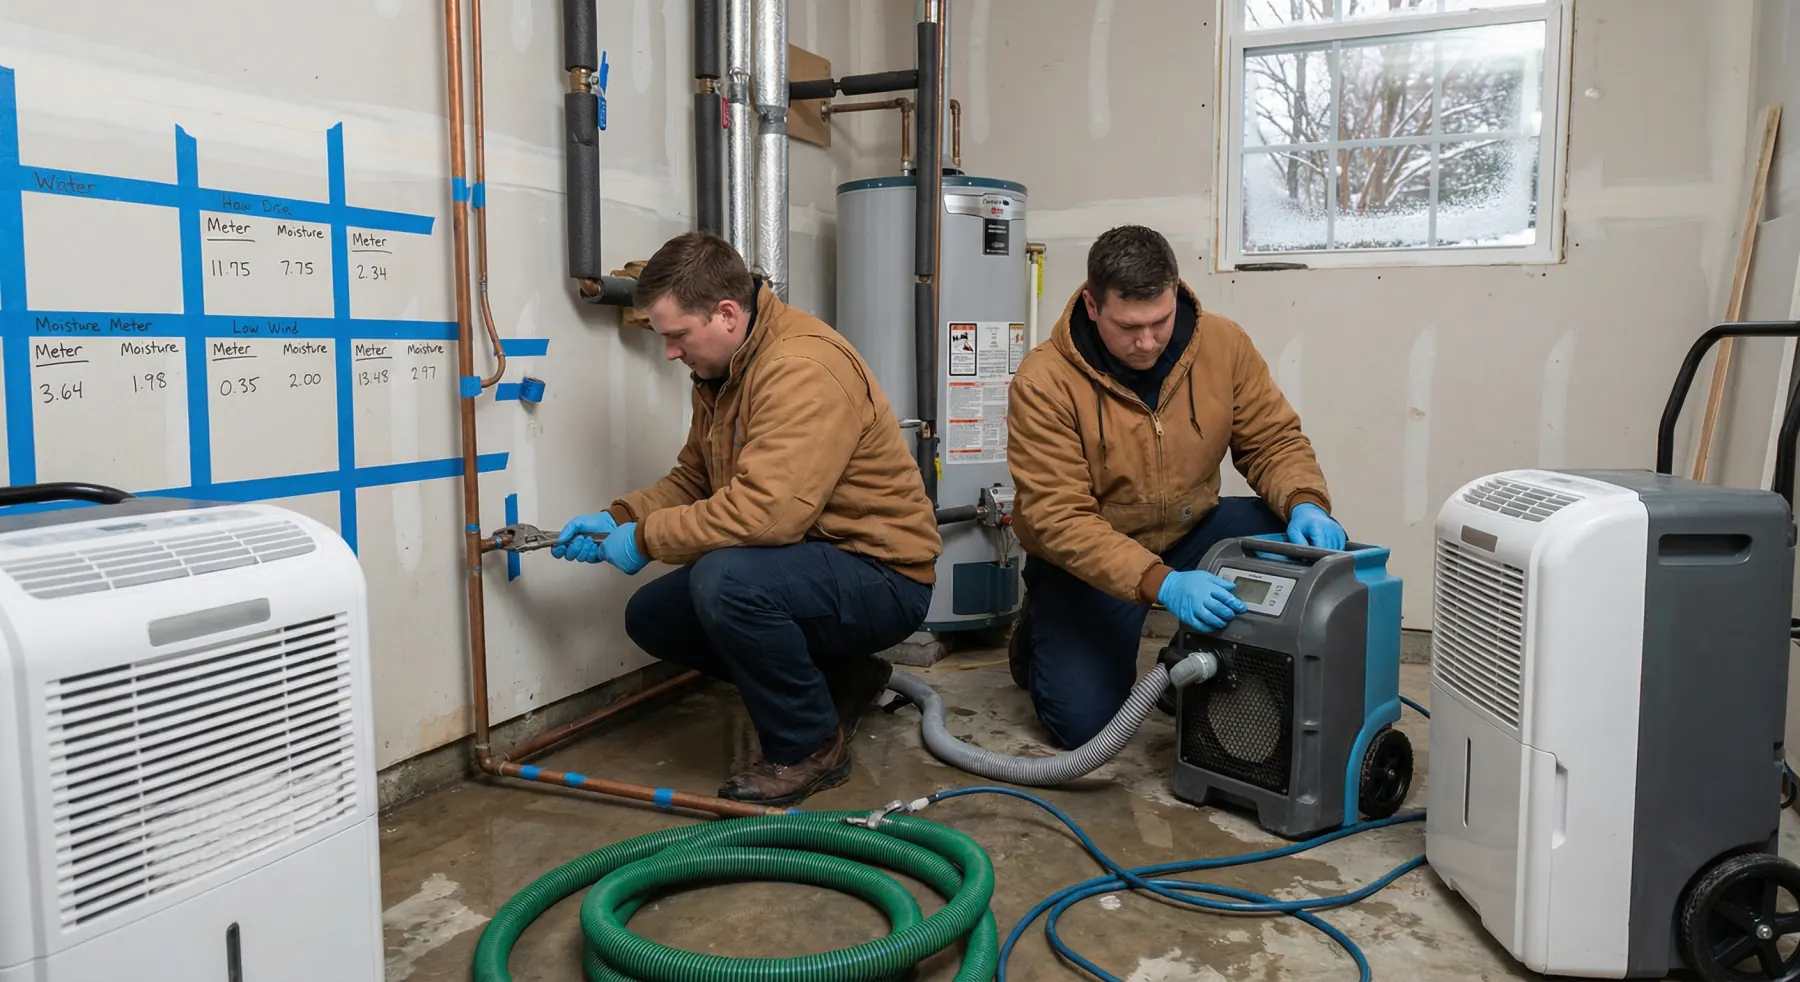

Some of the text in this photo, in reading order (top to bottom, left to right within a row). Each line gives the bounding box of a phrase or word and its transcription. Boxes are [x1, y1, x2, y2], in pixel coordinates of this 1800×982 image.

[33, 171, 96, 194] Water
[207, 217, 325, 239] Meter Moisture
[352, 233, 388, 248] Meter
[211, 259, 314, 277] 11.75 7.75
[356, 264, 388, 281] 2.34
[35, 316, 154, 333] Moisture Meter
[233, 319, 299, 335] Low Wind
[35, 340, 180, 360] Meter Moisture
[213, 341, 328, 356] Meter Moisture
[355, 341, 445, 357] Meter Moisture
[220, 373, 322, 397] 0.35 2.00
[358, 369, 389, 387] 13.48
[39, 371, 167, 404] 3.64 1.98
